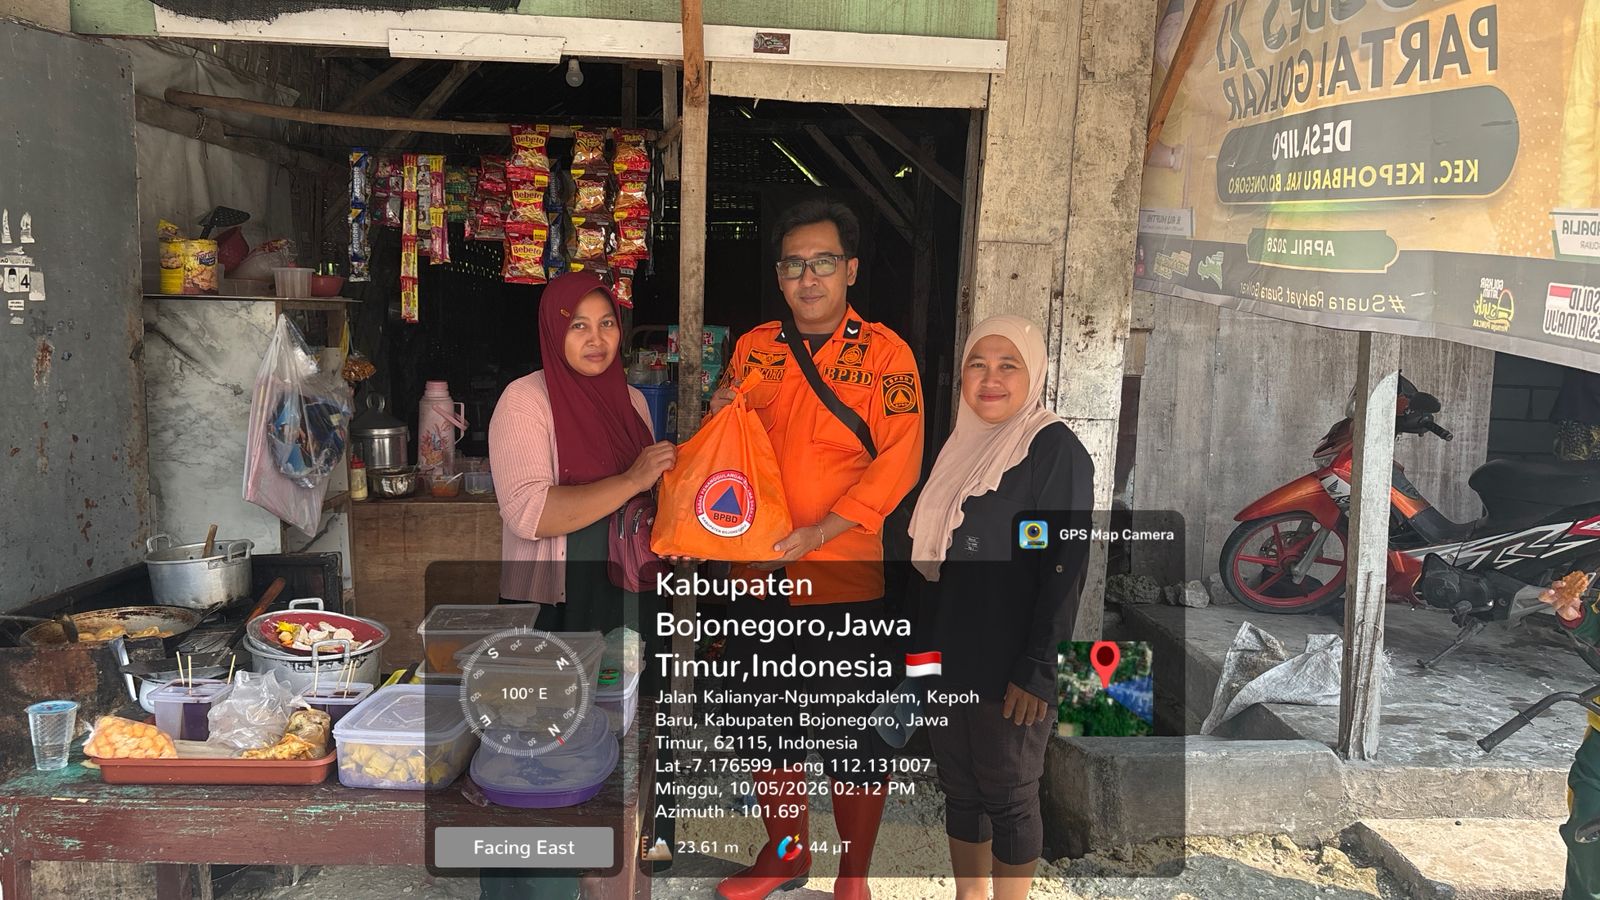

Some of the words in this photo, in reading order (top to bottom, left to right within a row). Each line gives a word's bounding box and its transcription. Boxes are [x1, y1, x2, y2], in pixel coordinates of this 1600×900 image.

[20, 274, 30, 289] 4
[827, 368, 873, 385] BPBD
[713, 512, 738, 524] BPBD
